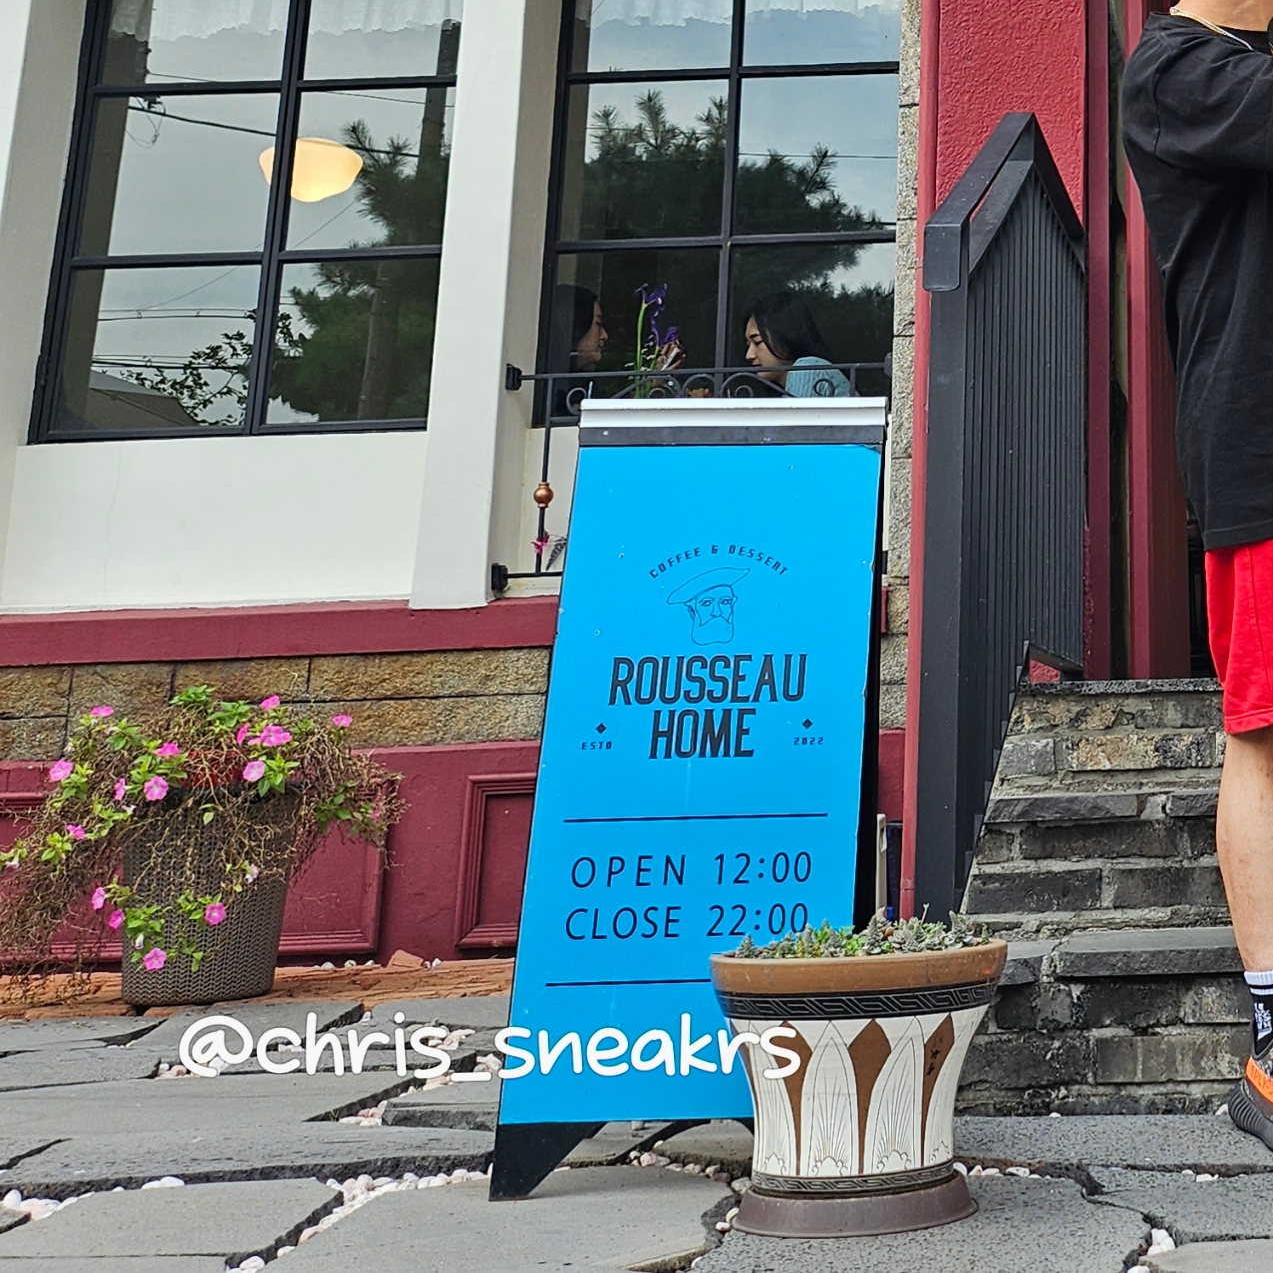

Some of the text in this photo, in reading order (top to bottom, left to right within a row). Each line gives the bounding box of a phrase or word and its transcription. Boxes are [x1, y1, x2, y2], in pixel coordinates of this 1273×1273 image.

[648, 544, 789, 579] COFFEE & DESSERT
[607, 652, 808, 707] ROUSSEAU
[647, 706, 757, 761] HOME
[793, 736, 825, 746] 2022
[570, 850, 812, 889] OPEN 12:00
[565, 902, 808, 941] CLOSE 22:00
